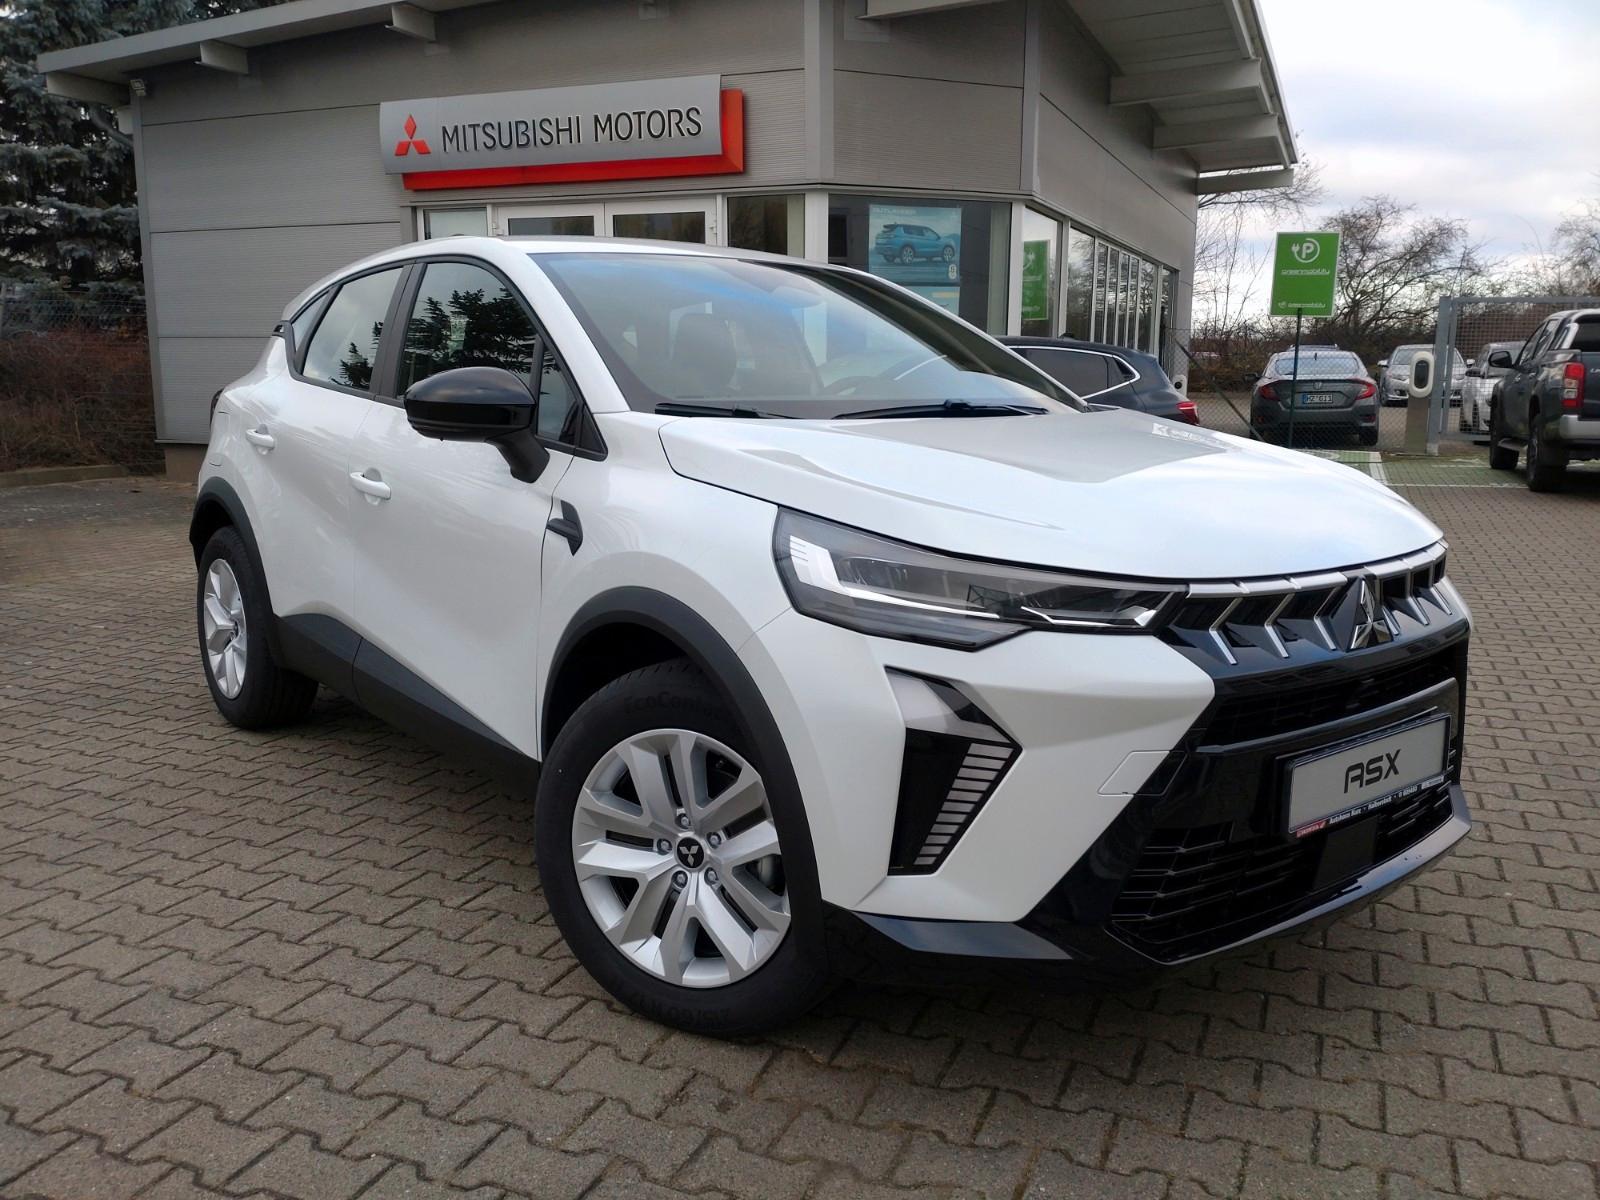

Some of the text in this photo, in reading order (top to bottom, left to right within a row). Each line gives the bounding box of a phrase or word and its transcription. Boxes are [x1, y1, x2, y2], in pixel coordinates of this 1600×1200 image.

[442, 106, 702, 152] MITSUBISHI MOTORS
[1301, 242, 1314, 259] P
[1343, 749, 1401, 794] ASX
